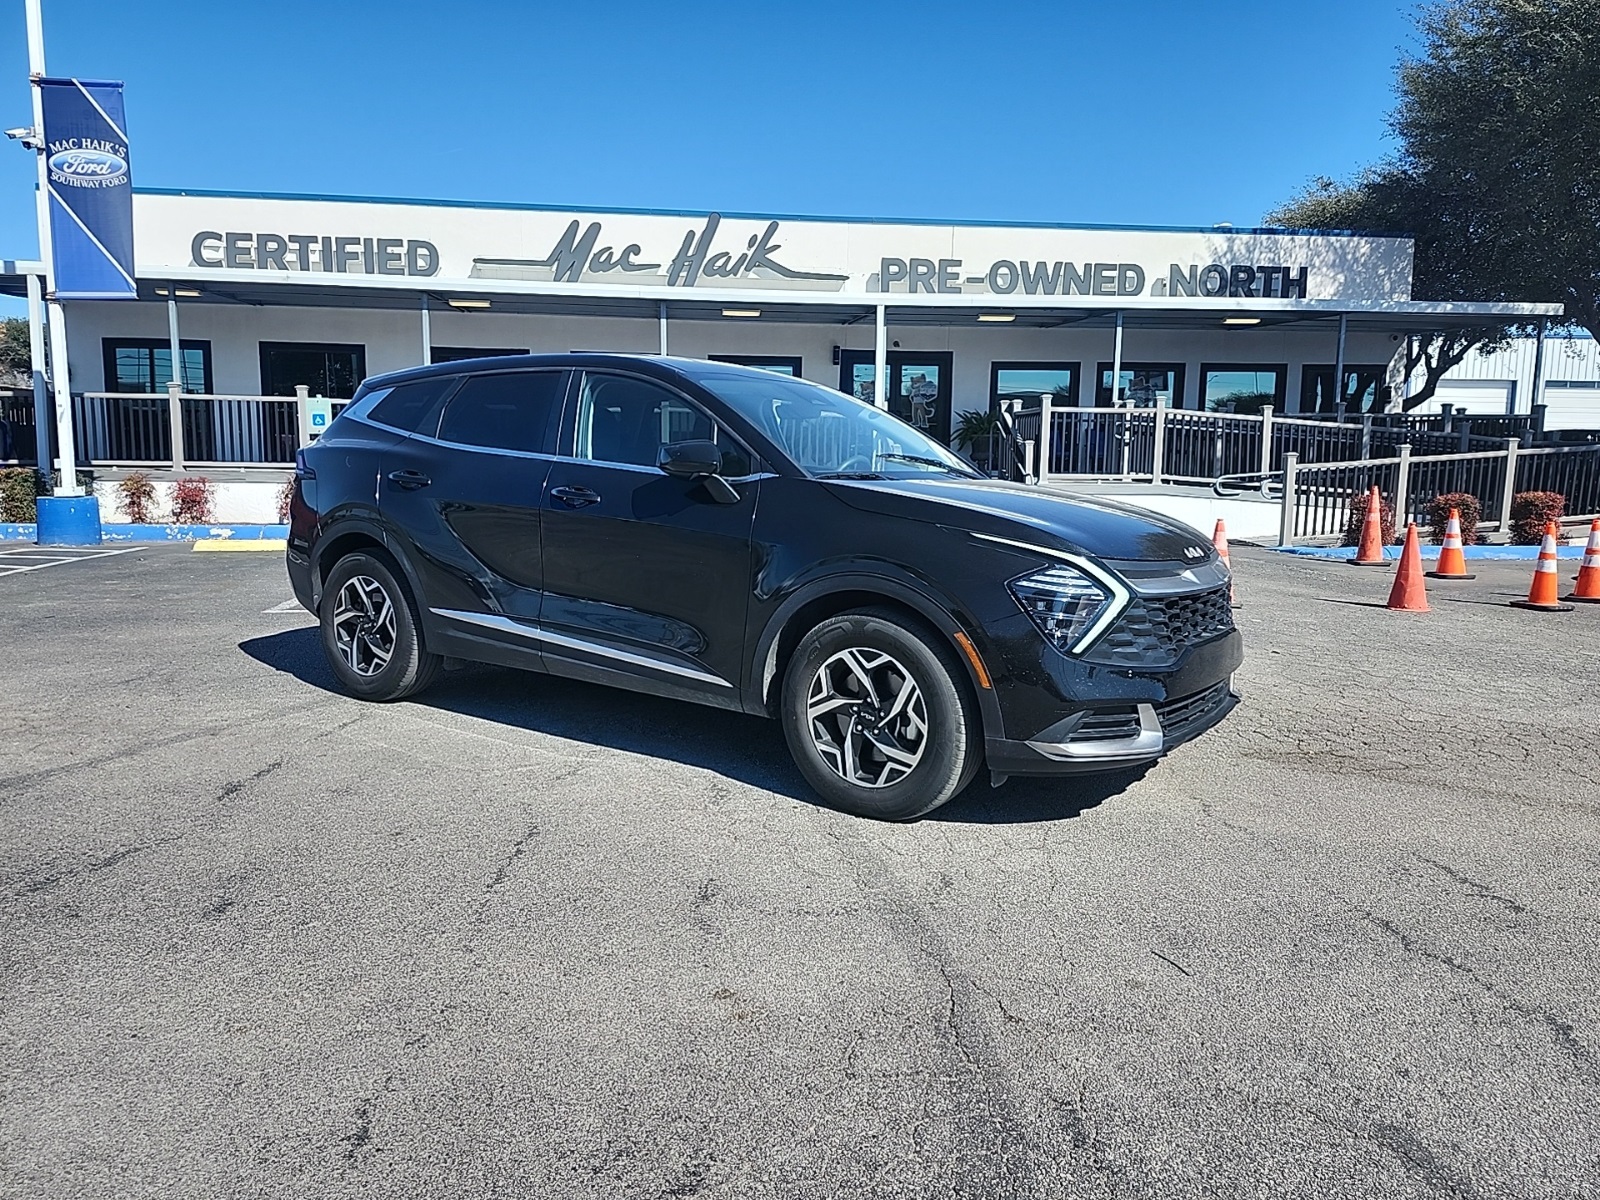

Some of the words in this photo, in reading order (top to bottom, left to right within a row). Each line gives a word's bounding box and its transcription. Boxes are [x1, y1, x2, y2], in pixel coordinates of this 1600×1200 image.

[49, 138, 78, 153] MAC
[81, 138, 127, 158] HAIK'S
[63, 154, 111, 174] Ford
[50, 172, 101, 189] SOUTHWAY
[102, 175, 128, 188] FORD
[191, 231, 440, 277] CERTIFIED
[473, 219, 661, 282] Mac
[667, 212, 850, 287] Haik
[880, 257, 1146, 297] PRE-OWNED
[1168, 263, 1309, 299] NORTH
